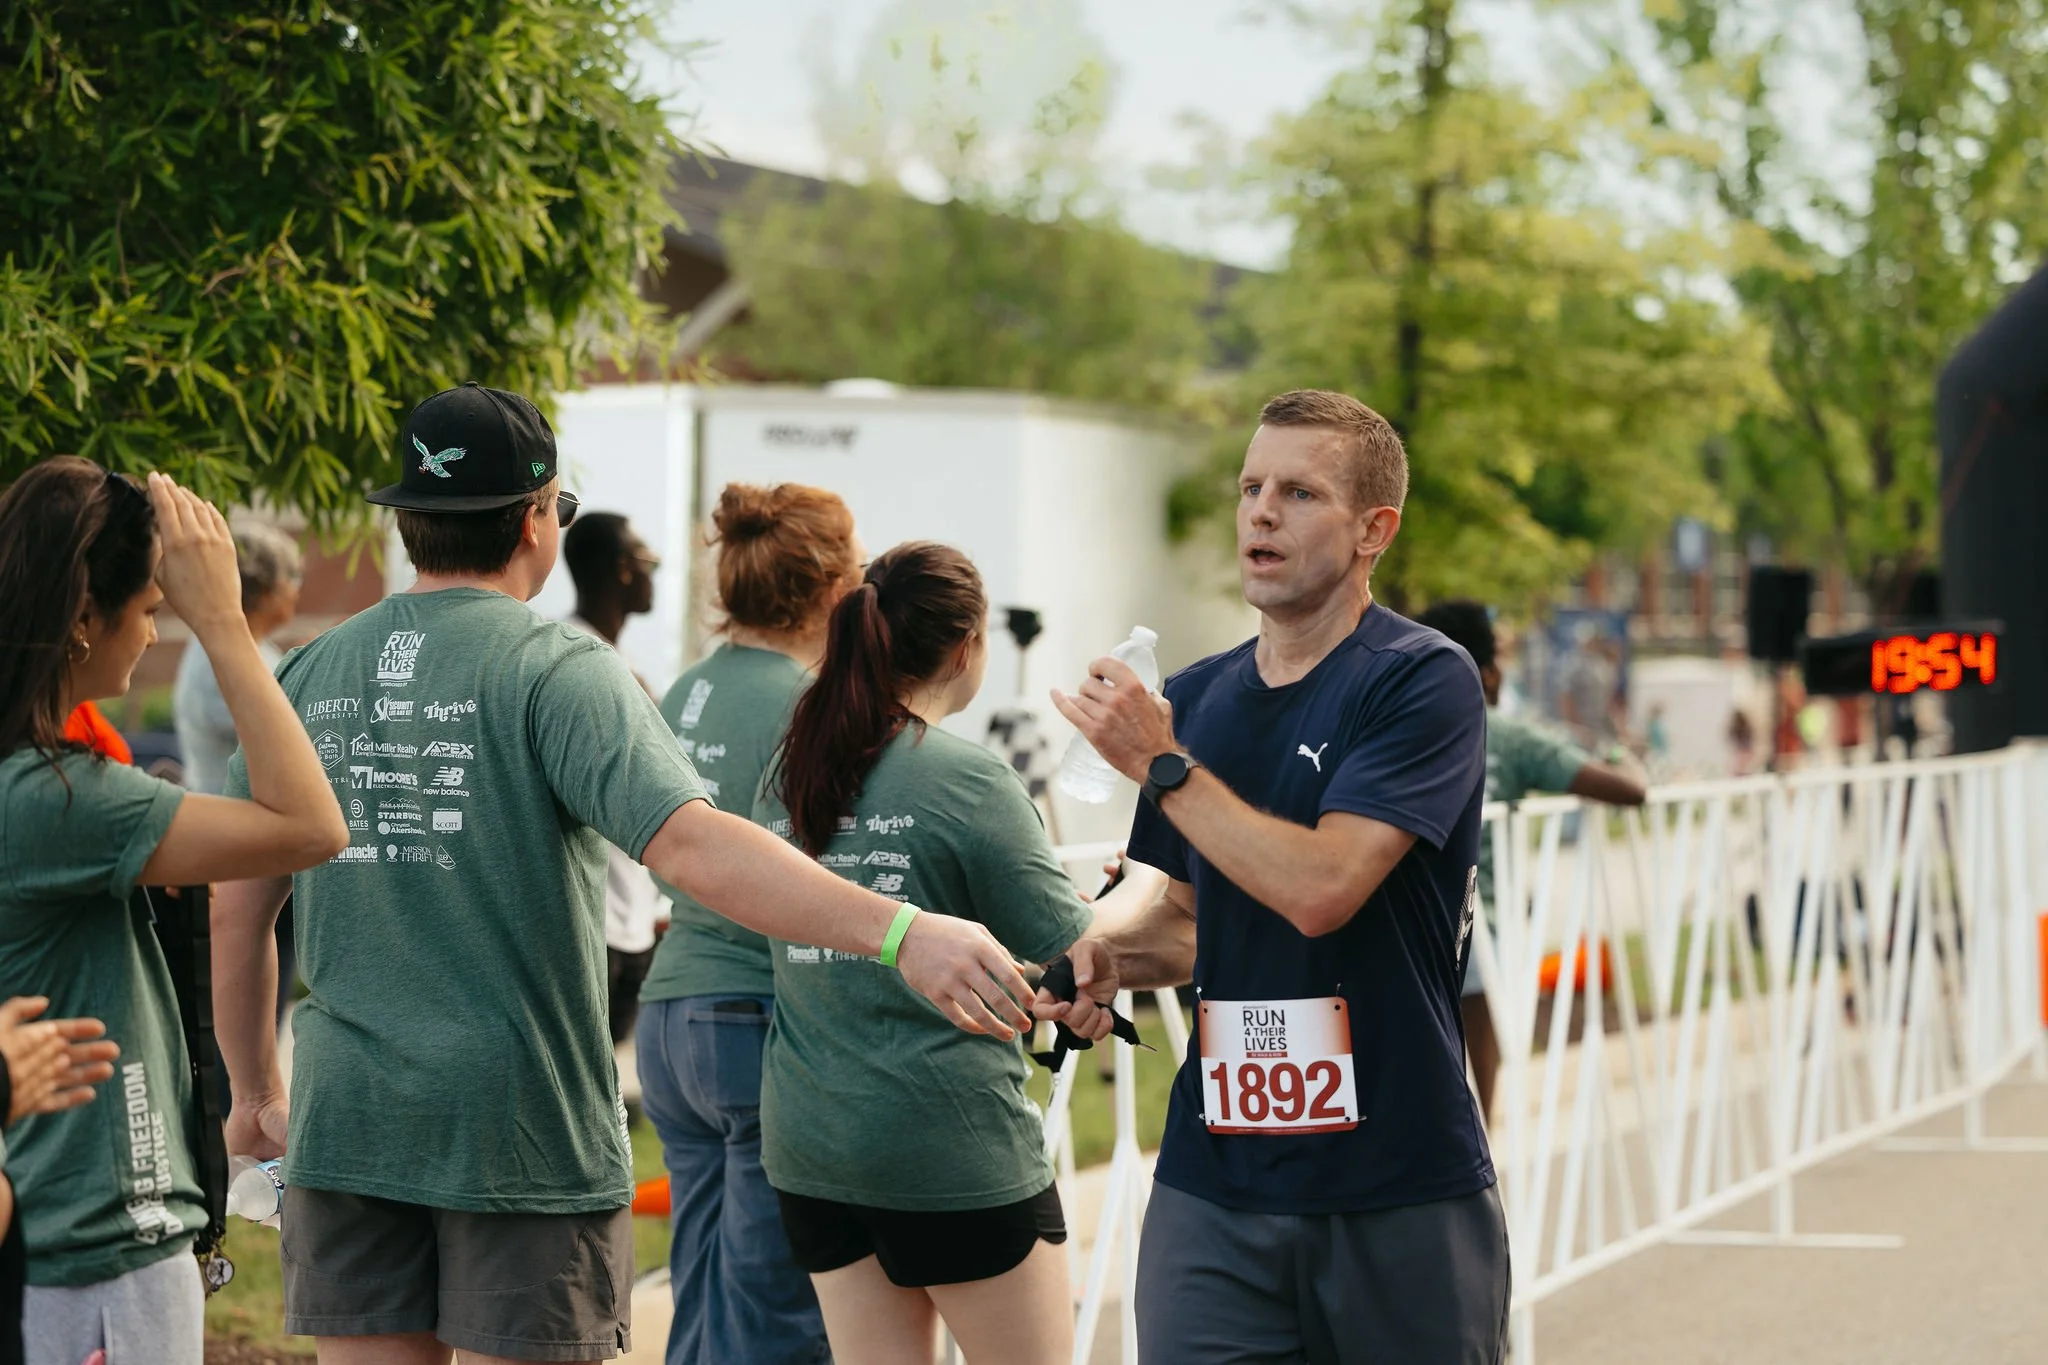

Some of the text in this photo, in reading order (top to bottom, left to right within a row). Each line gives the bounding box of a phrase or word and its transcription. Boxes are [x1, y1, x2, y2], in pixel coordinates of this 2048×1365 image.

[384, 633, 426, 651] RUN
[381, 649, 418, 660] 4 THEIR
[378, 658, 415, 672] LIVES
[306, 698, 361, 718] LIBERTY
[424, 700, 477, 722] Thrive
[306, 713, 359, 723] UNIVERSITY
[356, 741, 373, 751] Karl
[375, 742, 397, 753] Miller
[397, 743, 419, 756] Realty
[421, 741, 475, 757] APEX
[373, 771, 418, 786] MOORE'S
[423, 788, 439, 796] new
[440, 786, 470, 798] balance
[349, 820, 369, 828] BATES
[866, 814, 914, 834] Thrive
[863, 850, 911, 868] APEX
[1243, 1009, 1286, 1027] RUN
[1244, 1027, 1286, 1036] 4 THEIR
[1245, 1037, 1288, 1051] LIVES
[1210, 1060, 1346, 1122] 1892
[122, 1061, 154, 1175] FREEDOM
